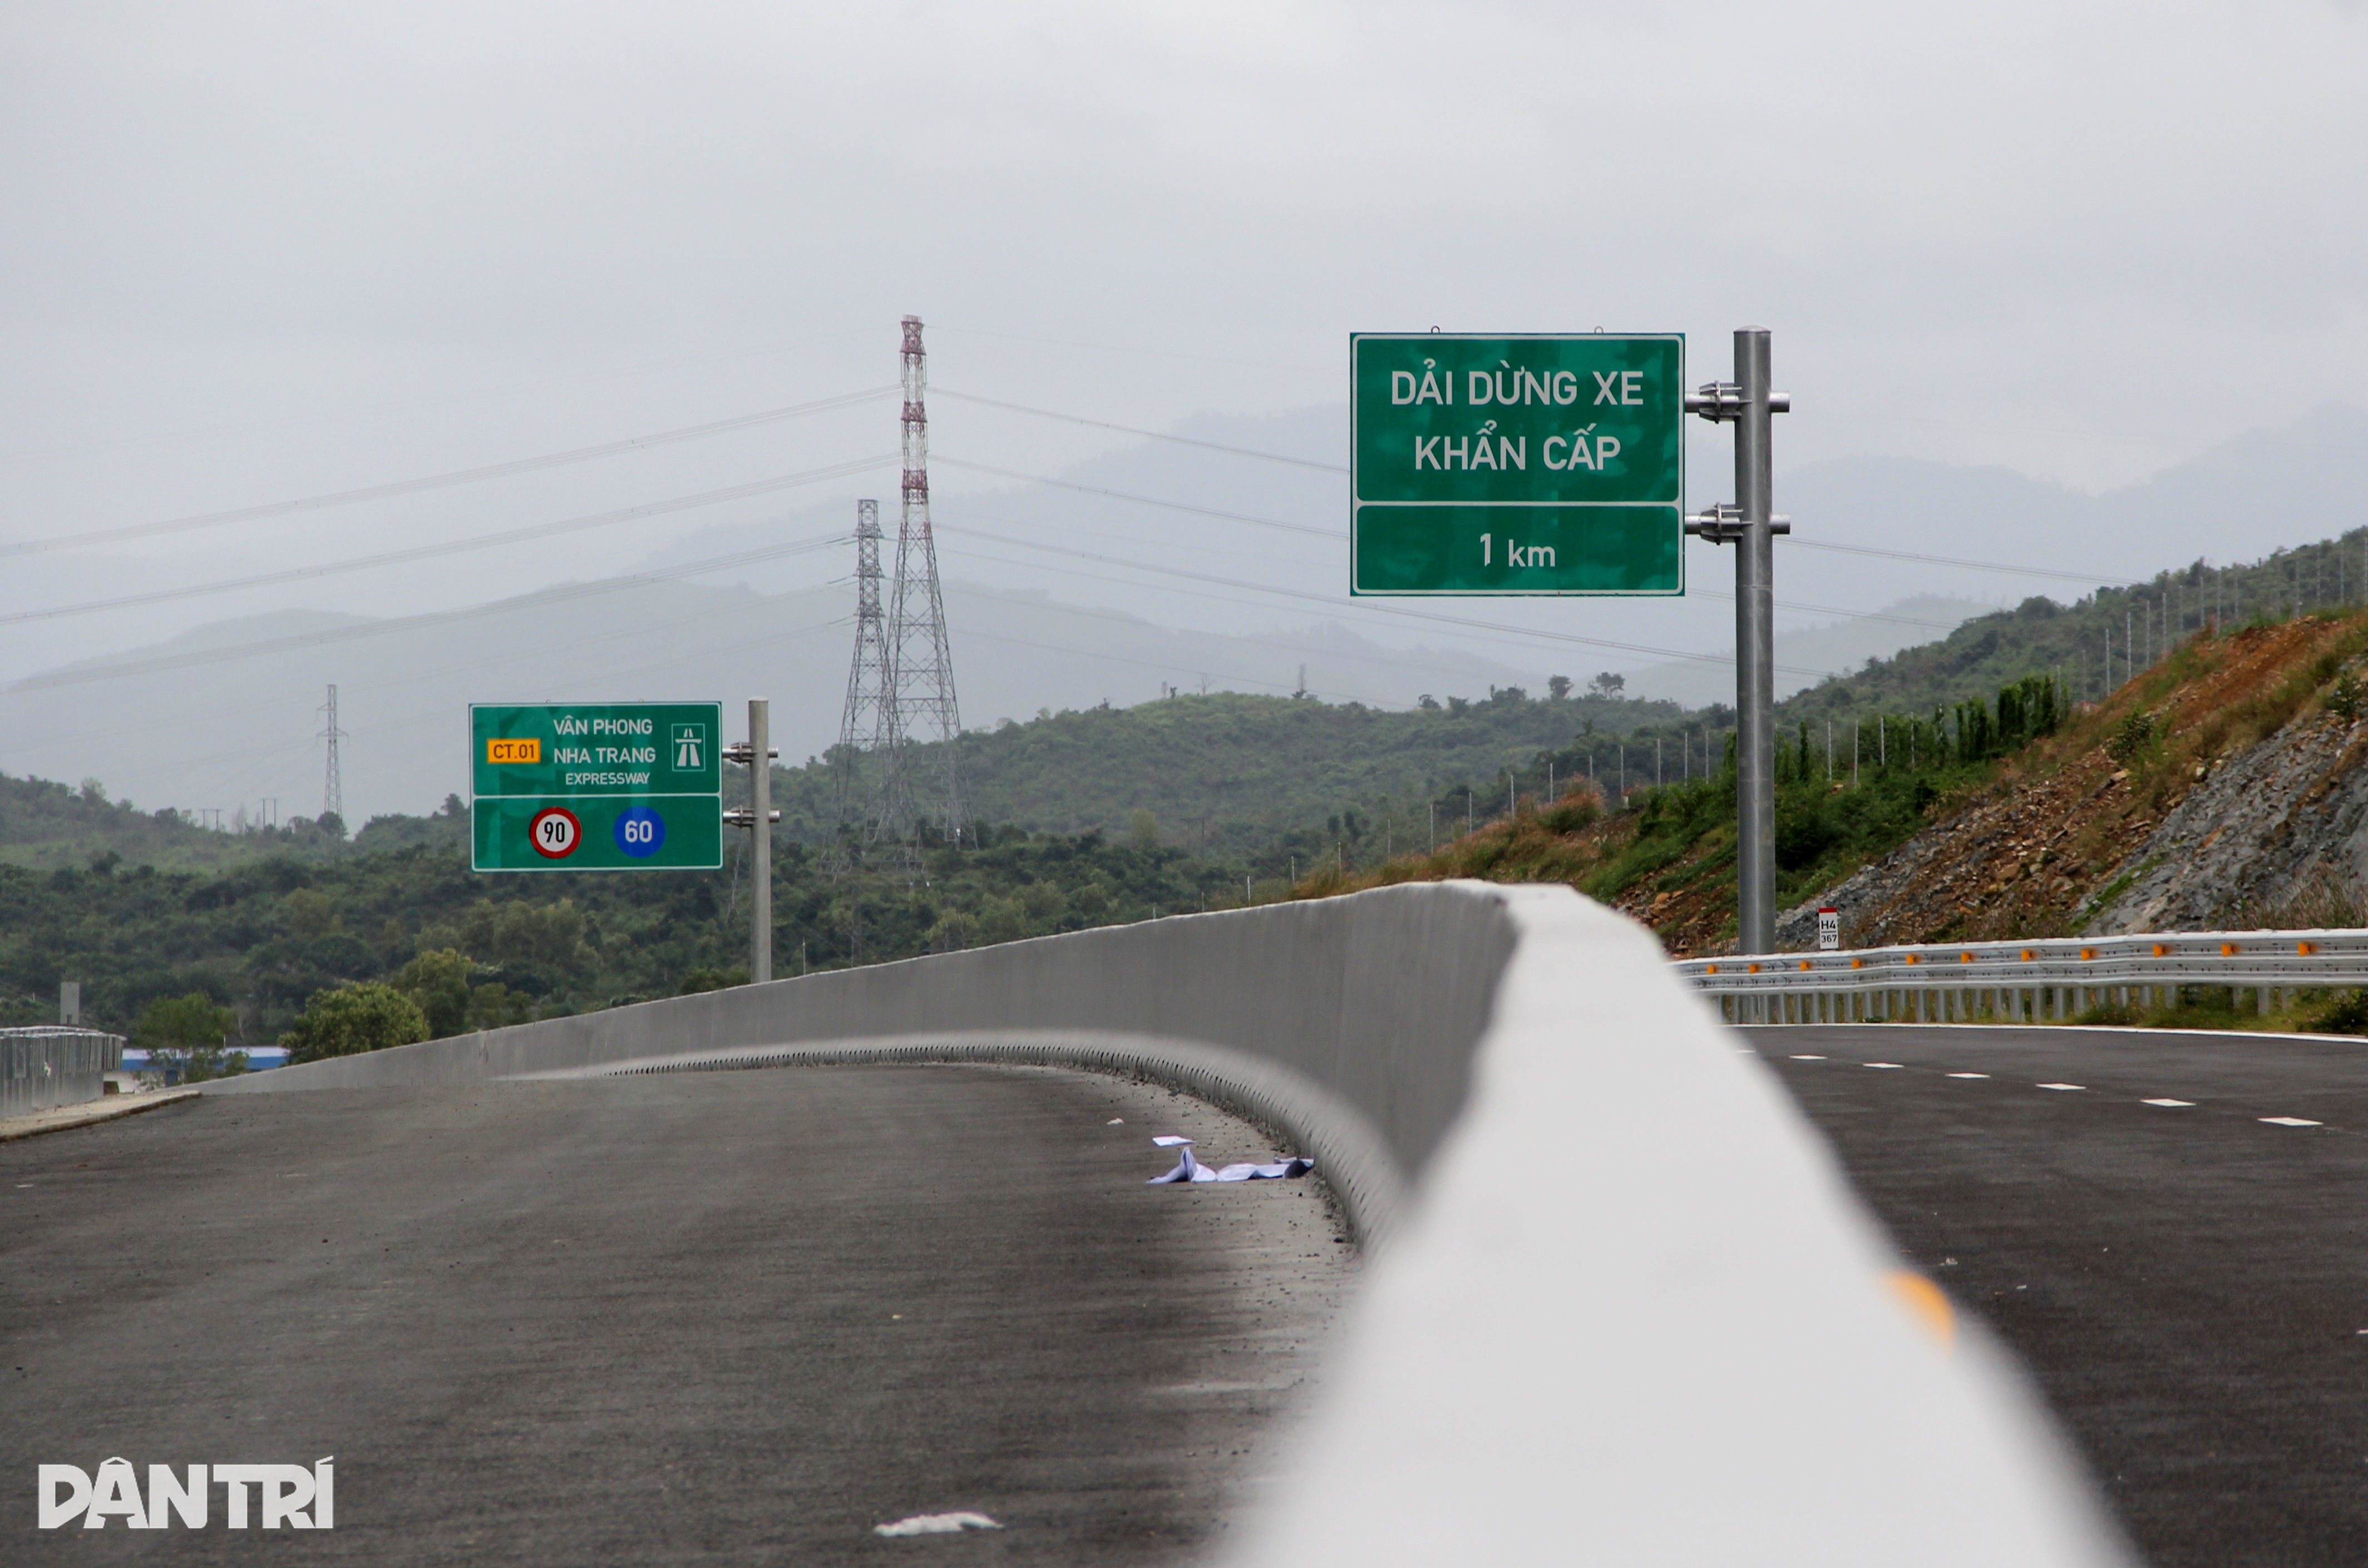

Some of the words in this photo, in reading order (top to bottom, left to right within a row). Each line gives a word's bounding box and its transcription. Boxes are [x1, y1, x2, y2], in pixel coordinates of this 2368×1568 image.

[1392, 358, 1452, 405] DẢI
[1469, 359, 1577, 405] DỪNG
[1592, 371, 1644, 405] XE
[1415, 420, 1526, 470] KHẨN
[1543, 423, 1621, 470] CẤP
[1480, 533, 1492, 566] 1
[1508, 539, 1556, 566] km
[554, 715, 588, 735] VÂN
[593, 719, 653, 734] PHONG
[493, 744, 535, 758] CT.01
[554, 748, 591, 764] NHA
[595, 747, 656, 763] TRANG
[565, 772, 650, 785] EXPRESSWAY
[544, 822, 565, 843] 90
[625, 820, 653, 843] 60
[1821, 920, 1836, 929] H4
